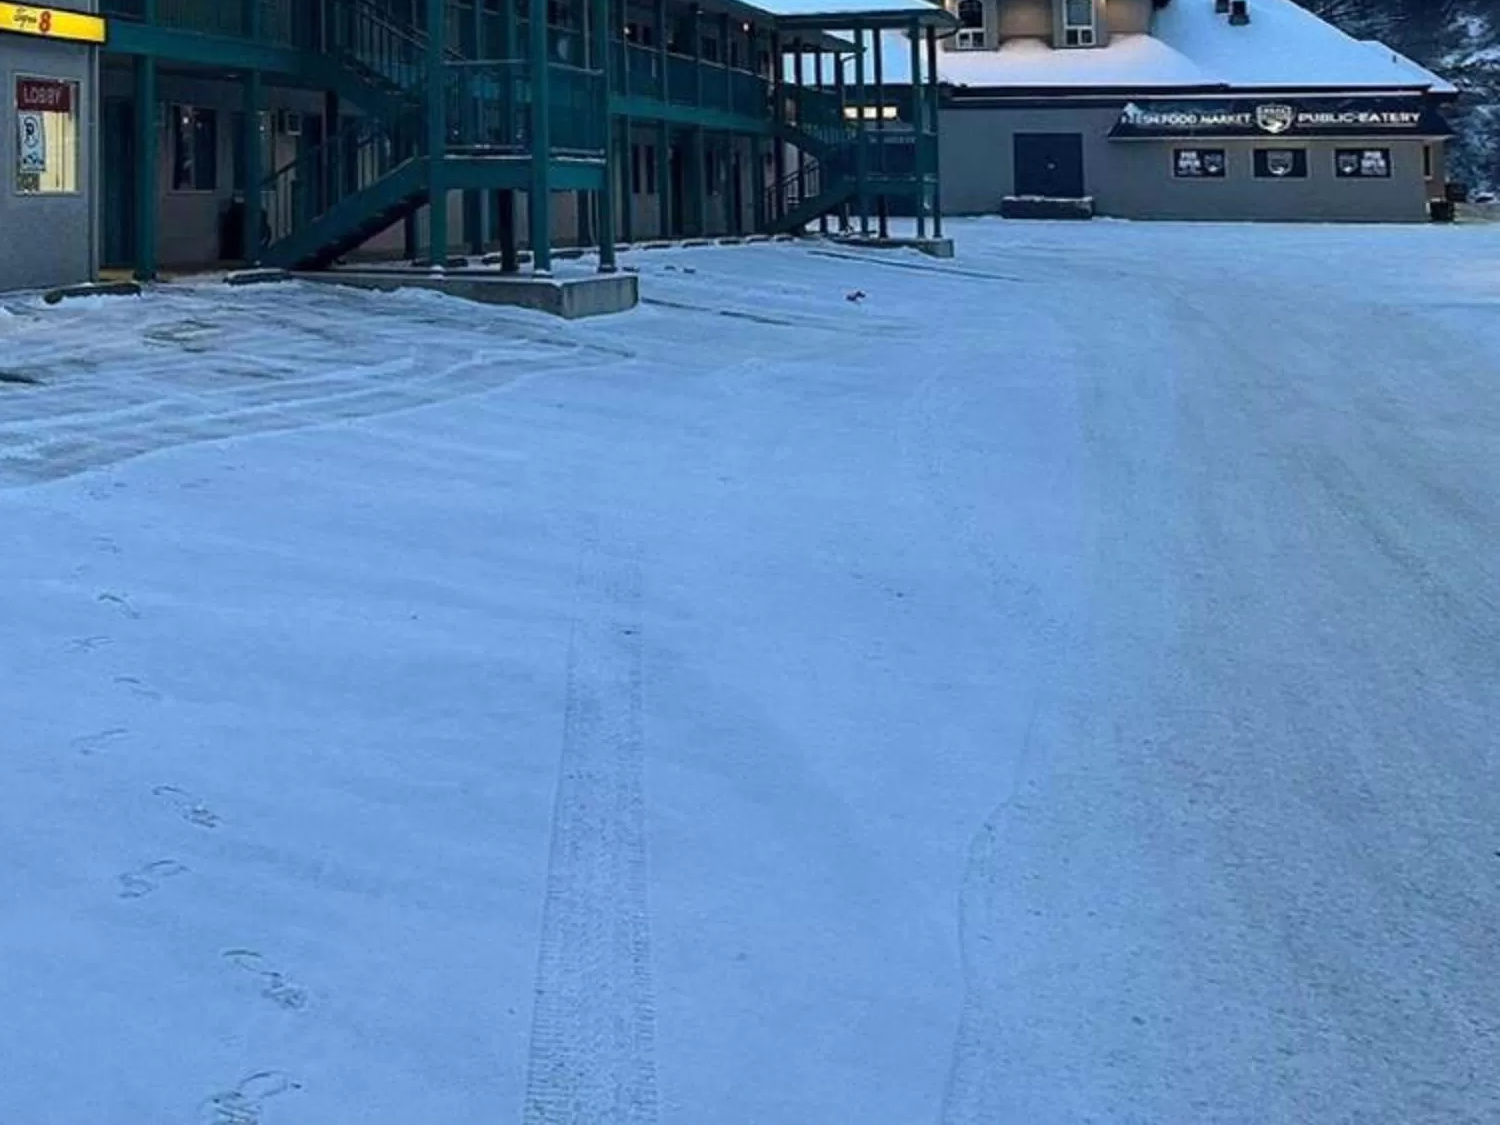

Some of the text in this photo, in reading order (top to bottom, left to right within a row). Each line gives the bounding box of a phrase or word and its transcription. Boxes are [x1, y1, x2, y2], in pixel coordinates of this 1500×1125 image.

[39, 10, 52, 32] 8
[23, 85, 62, 104] LOBBY
[1161, 112, 1197, 125] FOOD
[1200, 112, 1251, 125] MARKET
